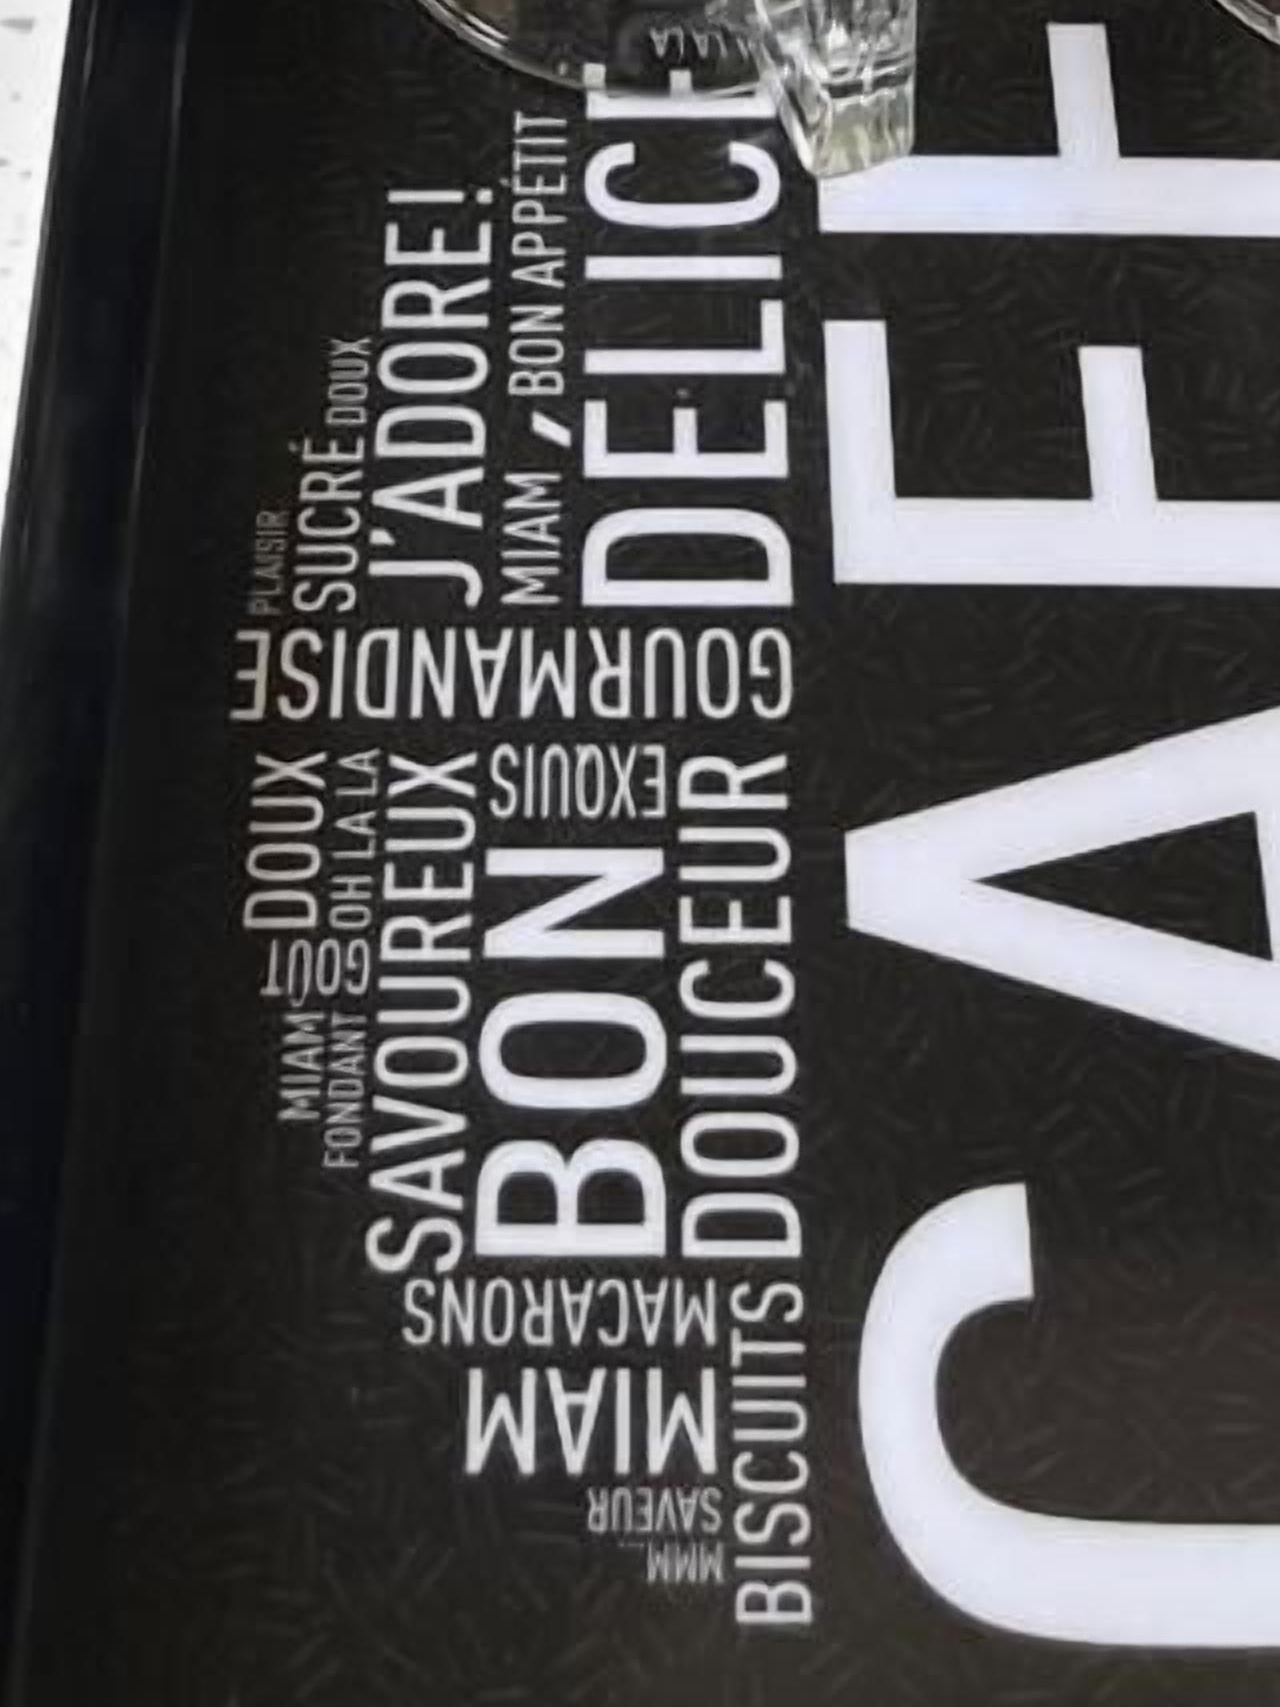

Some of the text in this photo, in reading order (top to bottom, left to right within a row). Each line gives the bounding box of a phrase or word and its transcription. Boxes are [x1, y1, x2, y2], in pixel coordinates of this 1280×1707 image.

[500, 112, 568, 395] BON APPÉTIT
[324, 337, 372, 426] DOUX
[367, 189, 493, 609] J'ADORE!
[249, 509, 289, 616] PLAISIR
[289, 436, 365, 613] SUCRÉ
[501, 472, 562, 605] MIAM
[229, 627, 793, 721] GOURMANDISE
[243, 752, 327, 929] DOUX
[328, 748, 380, 930] OH LA LA
[489, 744, 667, 819] EXQUIS
[277, 1013, 325, 1121] MIAM
[365, 752, 478, 1272] SAVOUREUX
[475, 848, 667, 1255] BON
[677, 753, 802, 1258] DOUCEUR
[324, 1011, 367, 1168] FONDANT
[403, 1277, 716, 1346] MACARONS
[464, 1367, 718, 1475] MIAM
[729, 1281, 813, 1624] BISCUITS
[586, 1487, 723, 1534] SAVEUR
